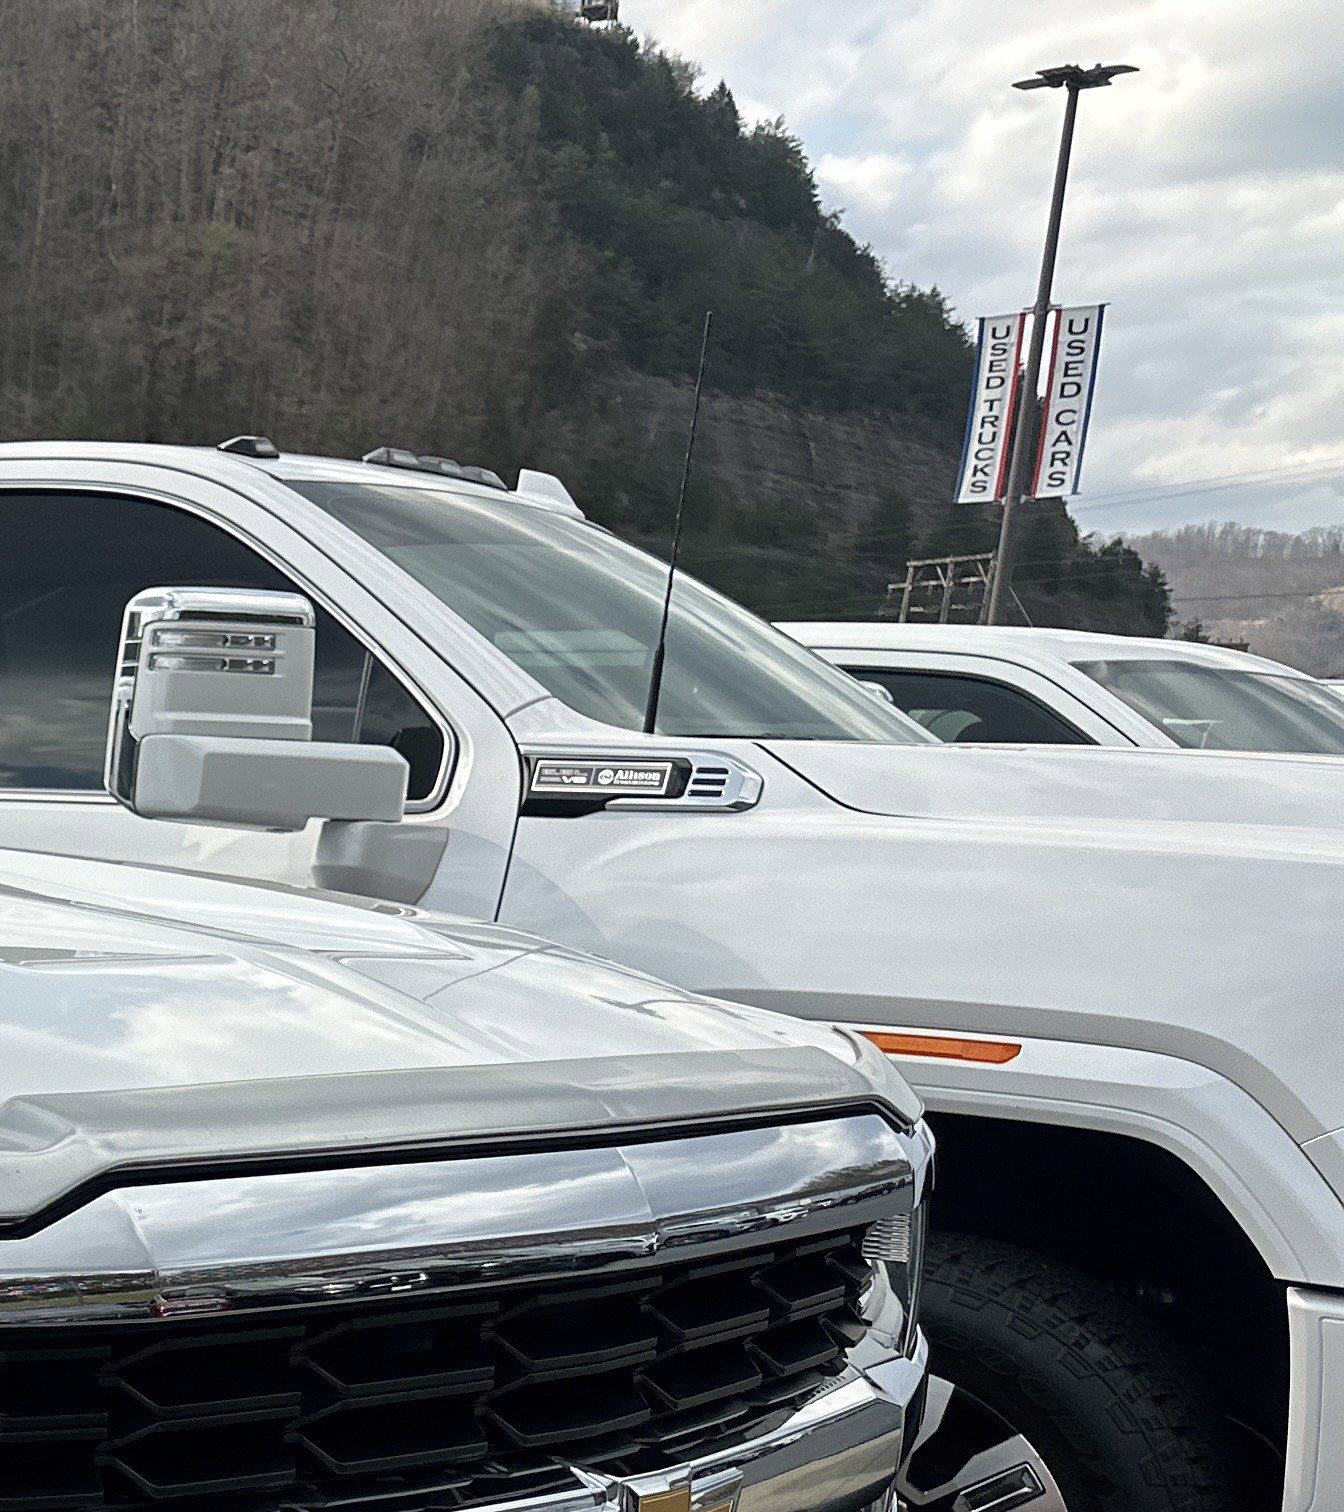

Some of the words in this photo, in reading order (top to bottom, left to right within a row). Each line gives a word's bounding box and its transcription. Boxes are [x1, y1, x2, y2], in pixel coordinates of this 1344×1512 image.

[985, 325, 1011, 390] USED
[1059, 316, 1090, 399] USED
[970, 398, 1002, 494] TRUCKS
[1046, 408, 1077, 488] CARS
[615, 769, 661, 781] Allison
